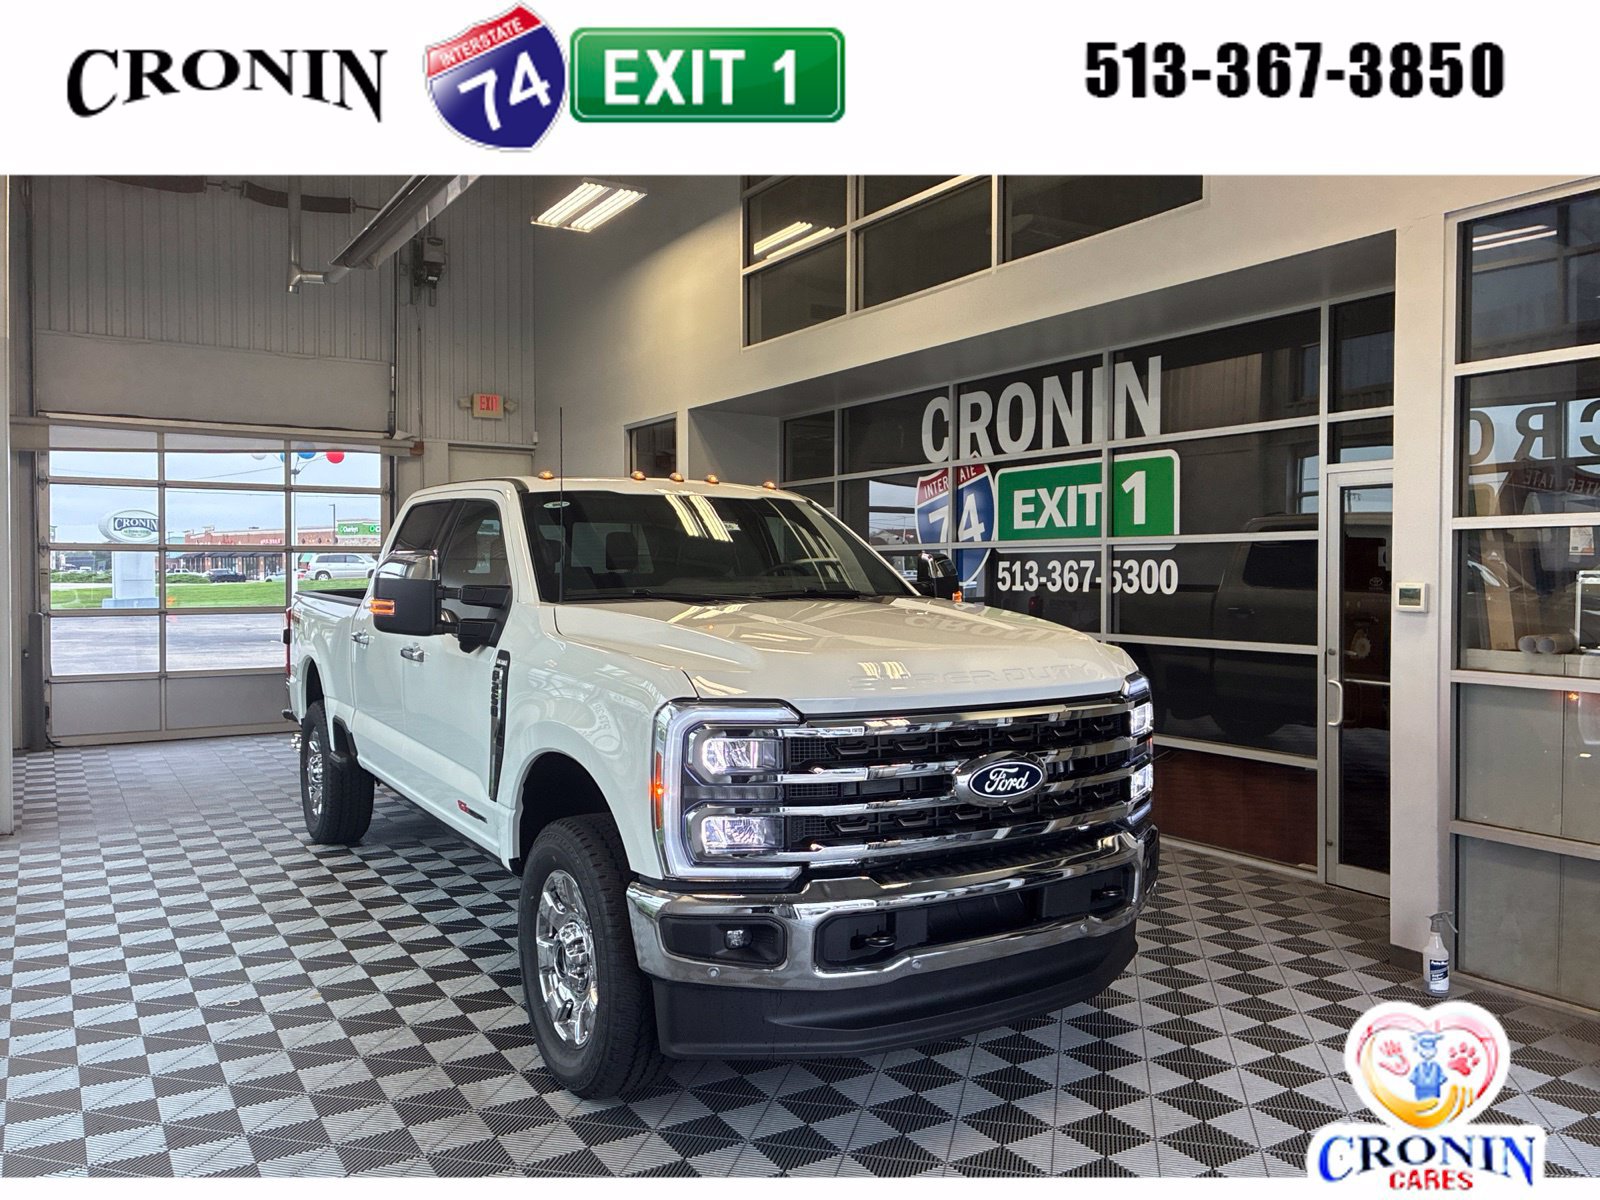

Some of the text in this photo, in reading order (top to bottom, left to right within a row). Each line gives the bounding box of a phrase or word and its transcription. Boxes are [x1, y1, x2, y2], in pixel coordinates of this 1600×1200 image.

[921, 355, 1161, 463] CRONIN
[928, 494, 986, 543] 74
[1013, 470, 1146, 530] EXIT 1
[997, 558, 1178, 594] 513-367-5300
[984, 767, 1030, 793] Ford
